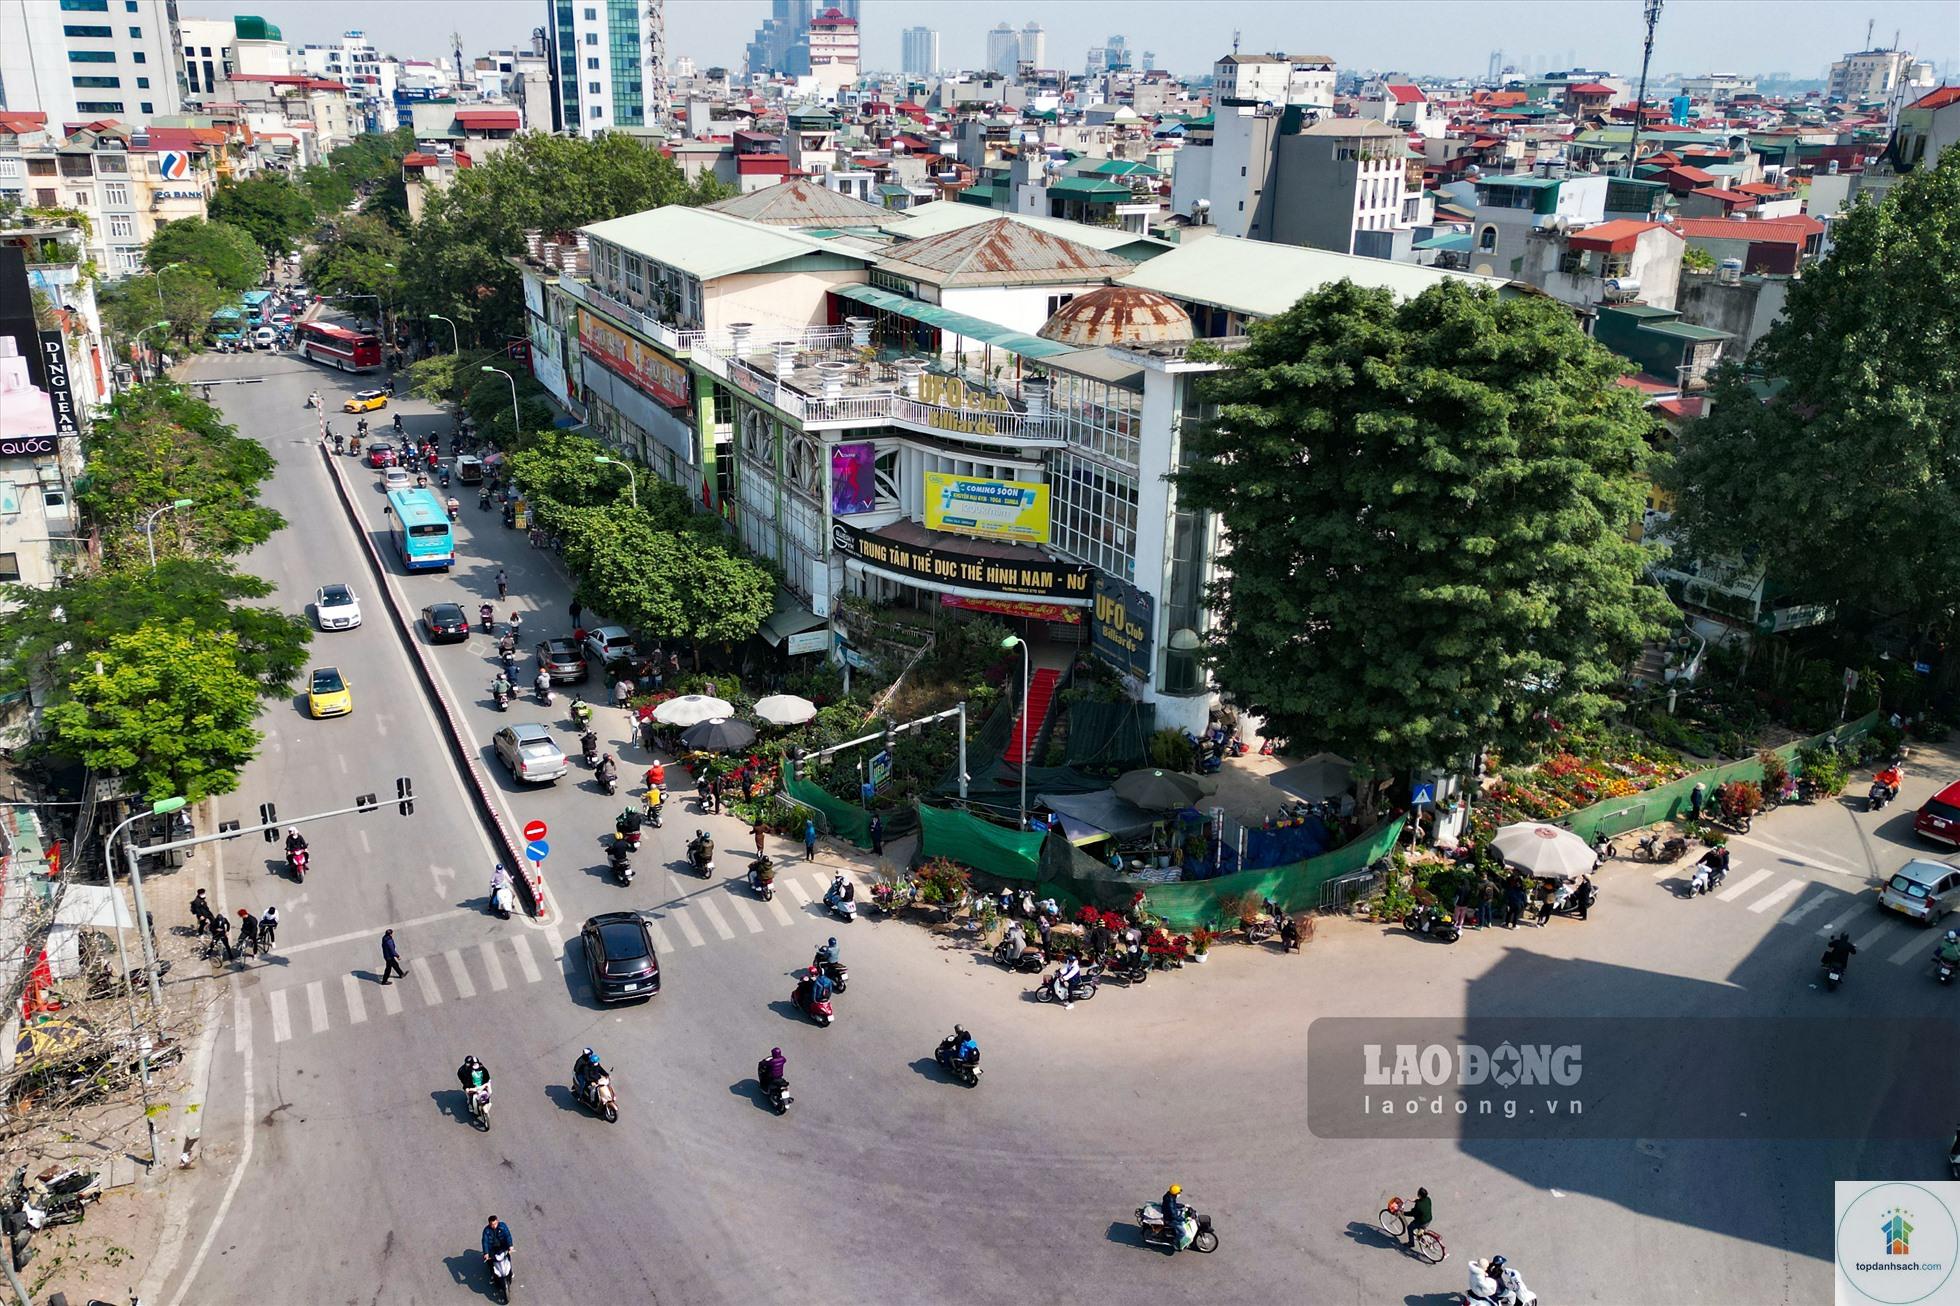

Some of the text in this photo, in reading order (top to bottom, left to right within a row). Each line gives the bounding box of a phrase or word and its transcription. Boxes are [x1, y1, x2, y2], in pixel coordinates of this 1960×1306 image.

[45, 342, 66, 387] DING
[53, 391, 74, 424] TEA
[919, 375, 1007, 410] UFO Club
[929, 411, 995, 435] Billiards
[1, 437, 52, 454] QUỐC
[966, 485, 1019, 497] COMING SOON
[859, 539, 887, 562] TRUNG
[889, 545, 909, 568] TÂM
[912, 550, 933, 573] THỂ
[935, 560, 957, 580] DỤC
[961, 558, 984, 582] THỂ
[987, 563, 1017, 585] HÌNH
[1021, 570, 1053, 588] NAM
[1096, 593, 1144, 641] UFO Club
[1102, 625, 1137, 652] Billiards
